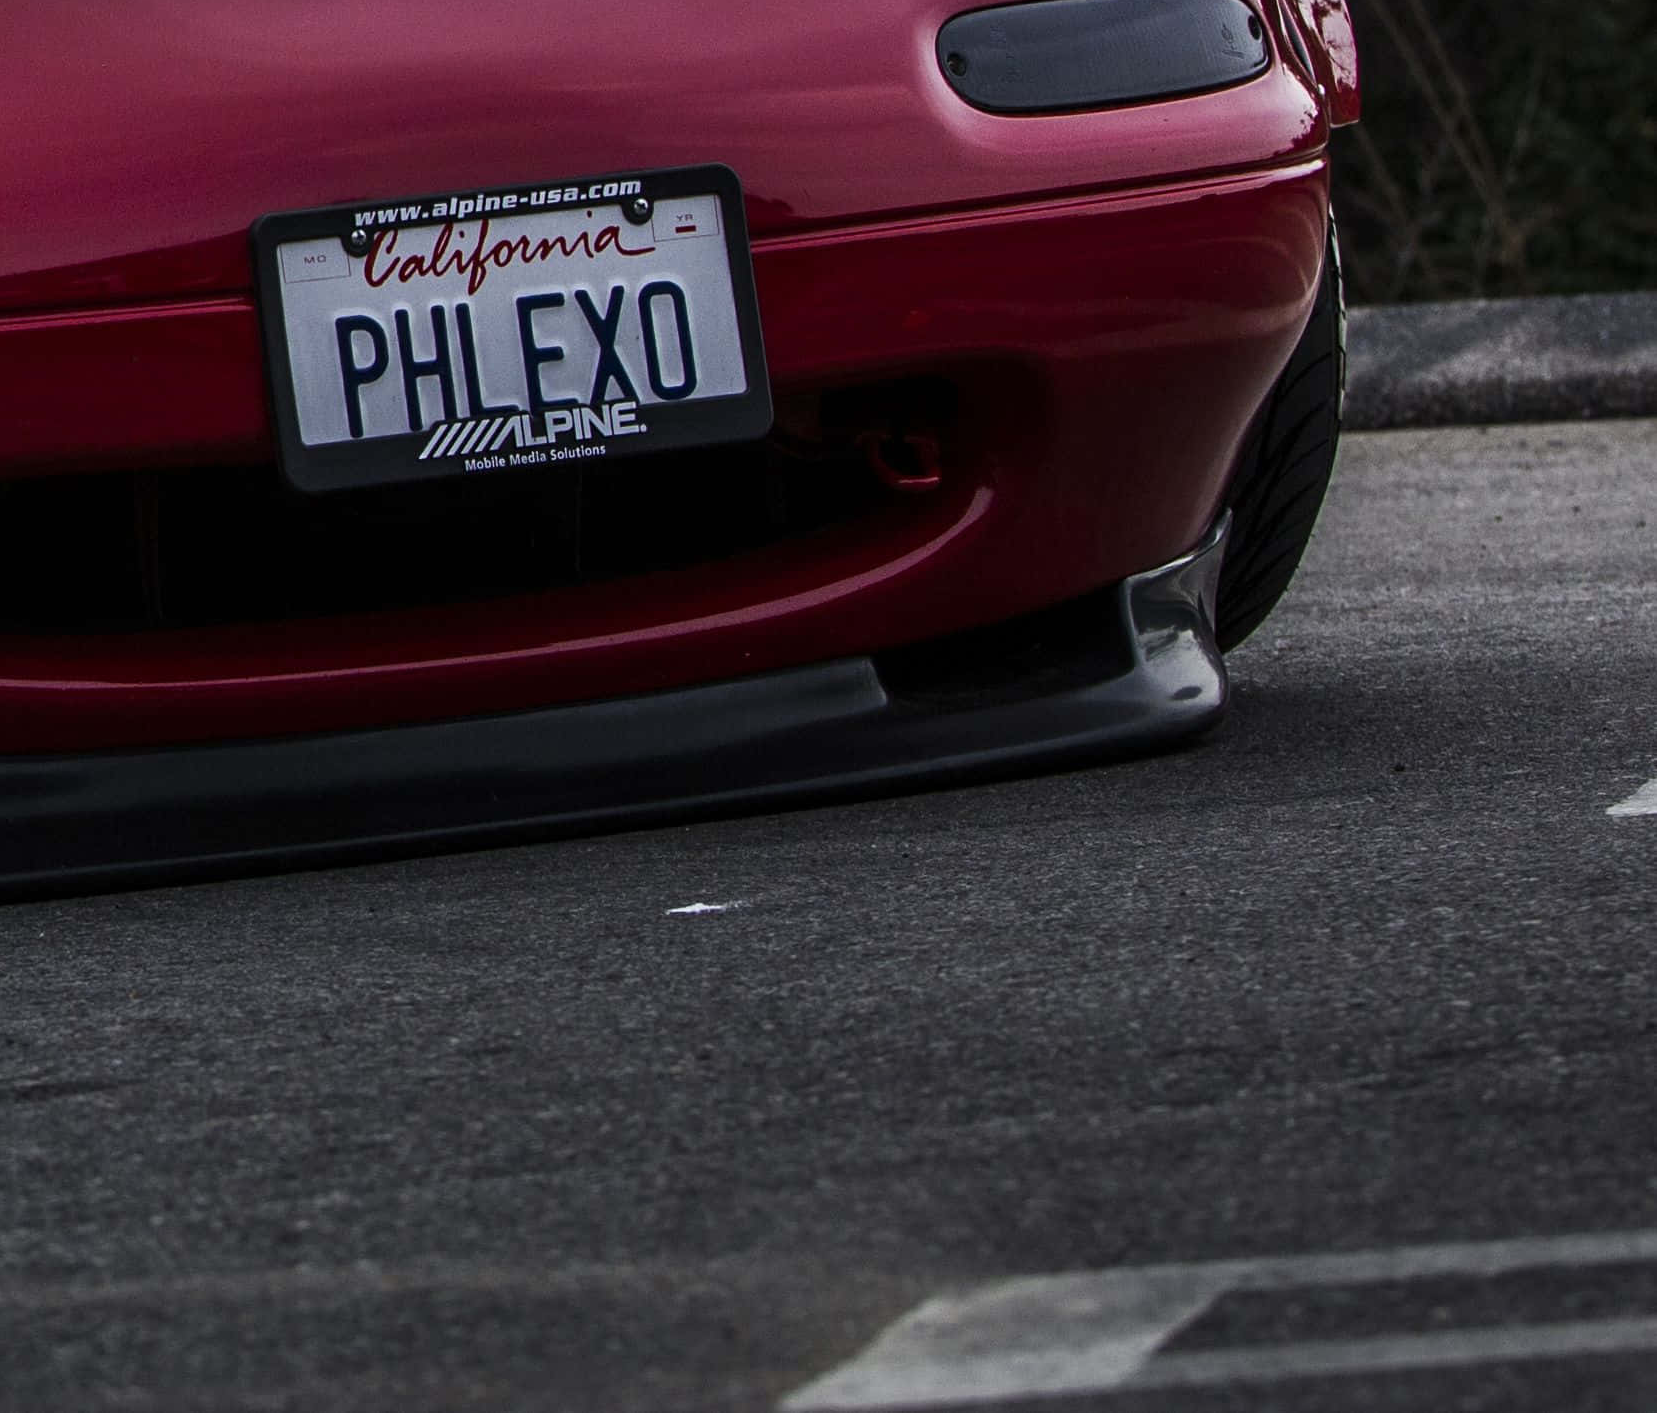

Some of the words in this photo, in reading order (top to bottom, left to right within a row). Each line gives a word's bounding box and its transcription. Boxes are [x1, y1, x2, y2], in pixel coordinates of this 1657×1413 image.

[354, 178, 642, 226] www.alpine-usa.com
[675, 212, 694, 223] YR
[303, 254, 327, 265] MO
[363, 209, 655, 295] California
[334, 280, 698, 438] PHLEXO
[464, 457, 506, 472] Mobile
[510, 451, 548, 467] Media
[550, 444, 607, 461] Solutions
